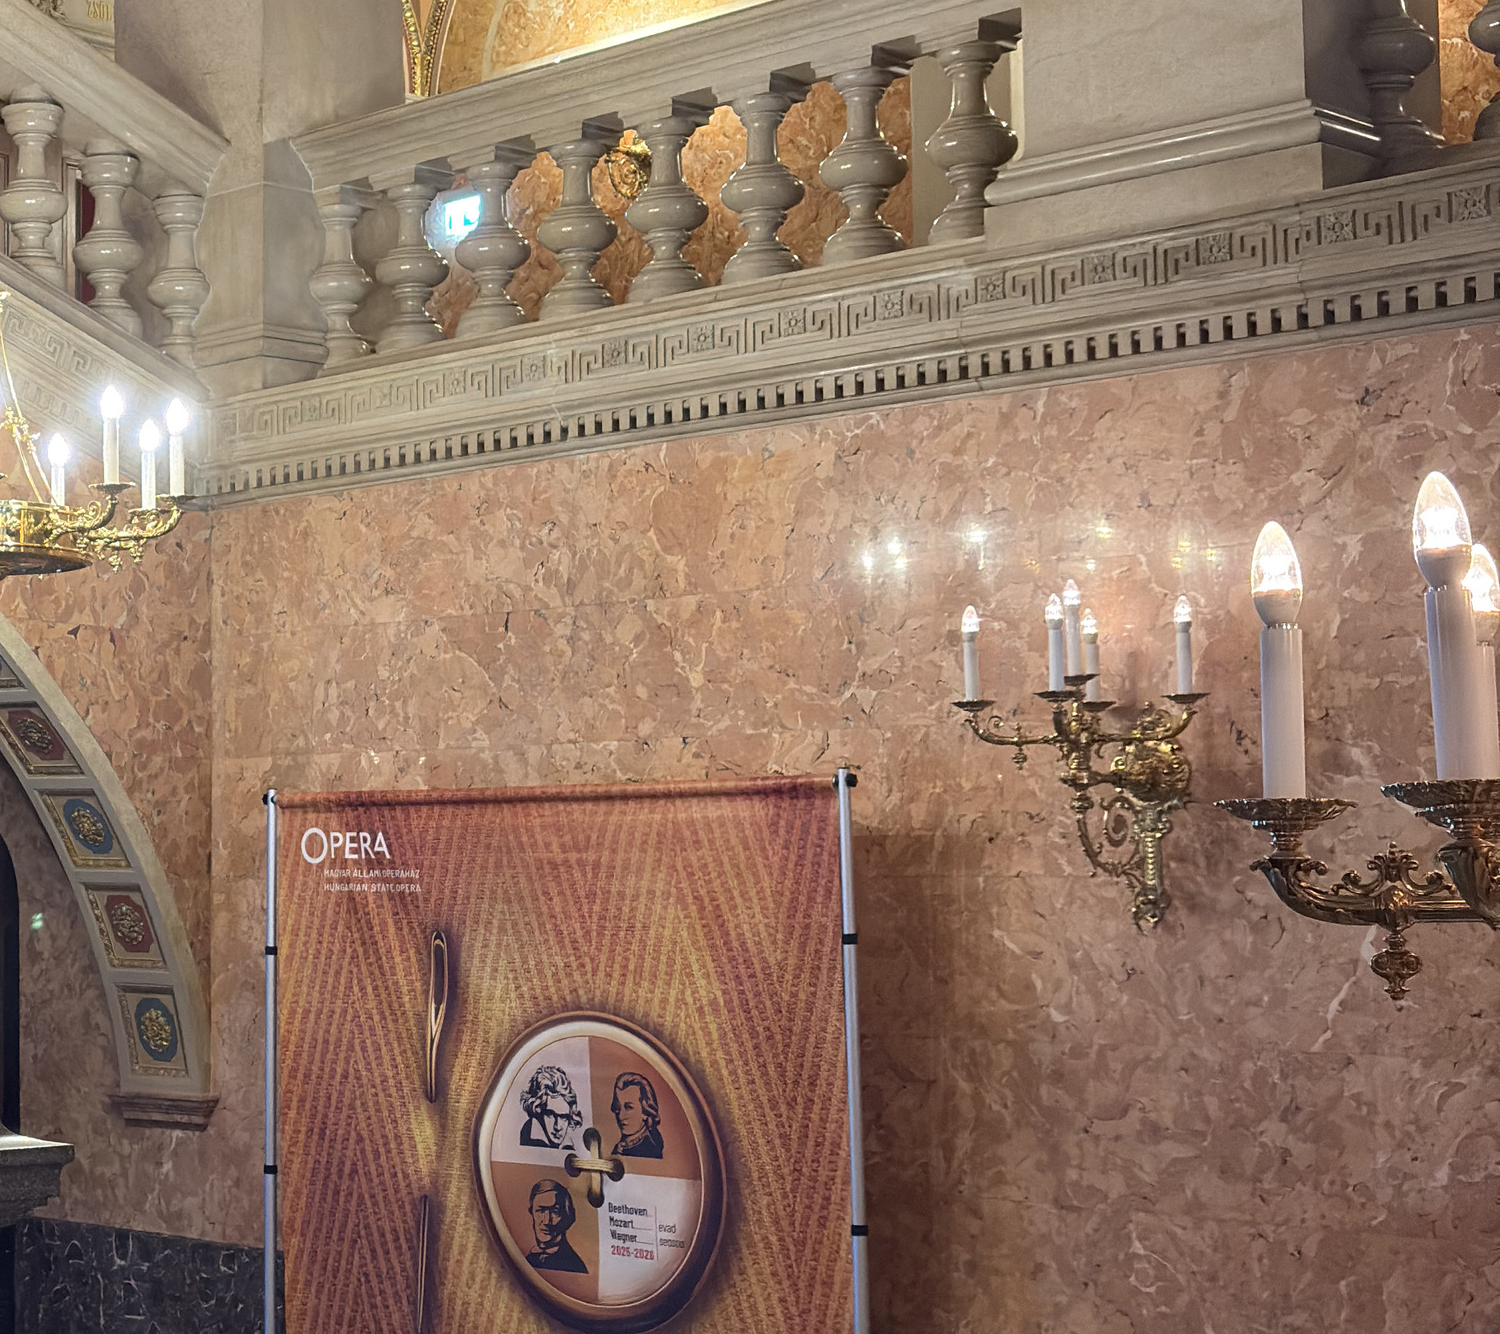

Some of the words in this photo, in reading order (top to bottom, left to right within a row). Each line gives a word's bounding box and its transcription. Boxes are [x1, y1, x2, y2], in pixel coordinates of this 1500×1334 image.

[301, 827, 391, 864] OPERA
[323, 869, 351, 878] MAGYAR
[323, 883, 368, 892] HUNGARIAN
[370, 883, 395, 892] STATE
[395, 883, 422, 893] OPERA
[608, 1202, 648, 1217] Beethoven
[609, 1216, 634, 1229] Mozart
[610, 1229, 637, 1244] Wagner
